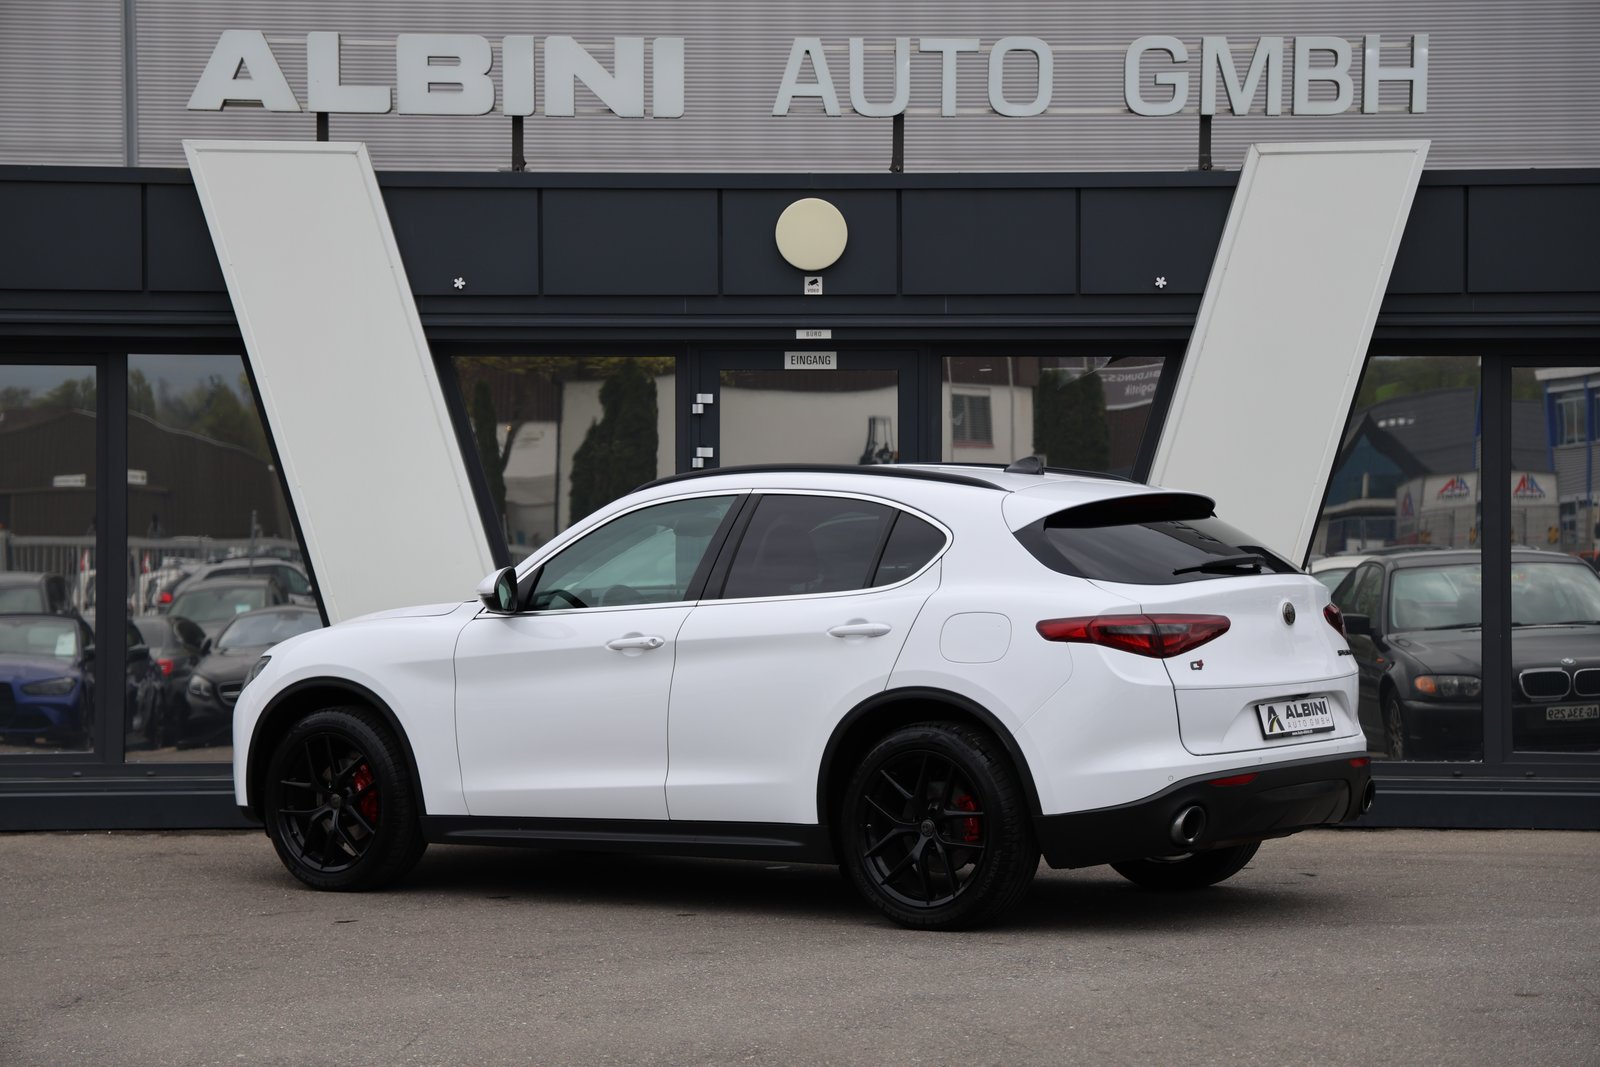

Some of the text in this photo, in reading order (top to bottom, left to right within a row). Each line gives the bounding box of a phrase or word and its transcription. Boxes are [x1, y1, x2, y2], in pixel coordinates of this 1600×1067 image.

[187, 29, 1429, 118] ALBINI AUTO GMBH
[790, 355, 831, 365] EINGANG
[1286, 700, 1328, 719] ALBINI
[1287, 716, 1331, 729] AUTO GMBH
